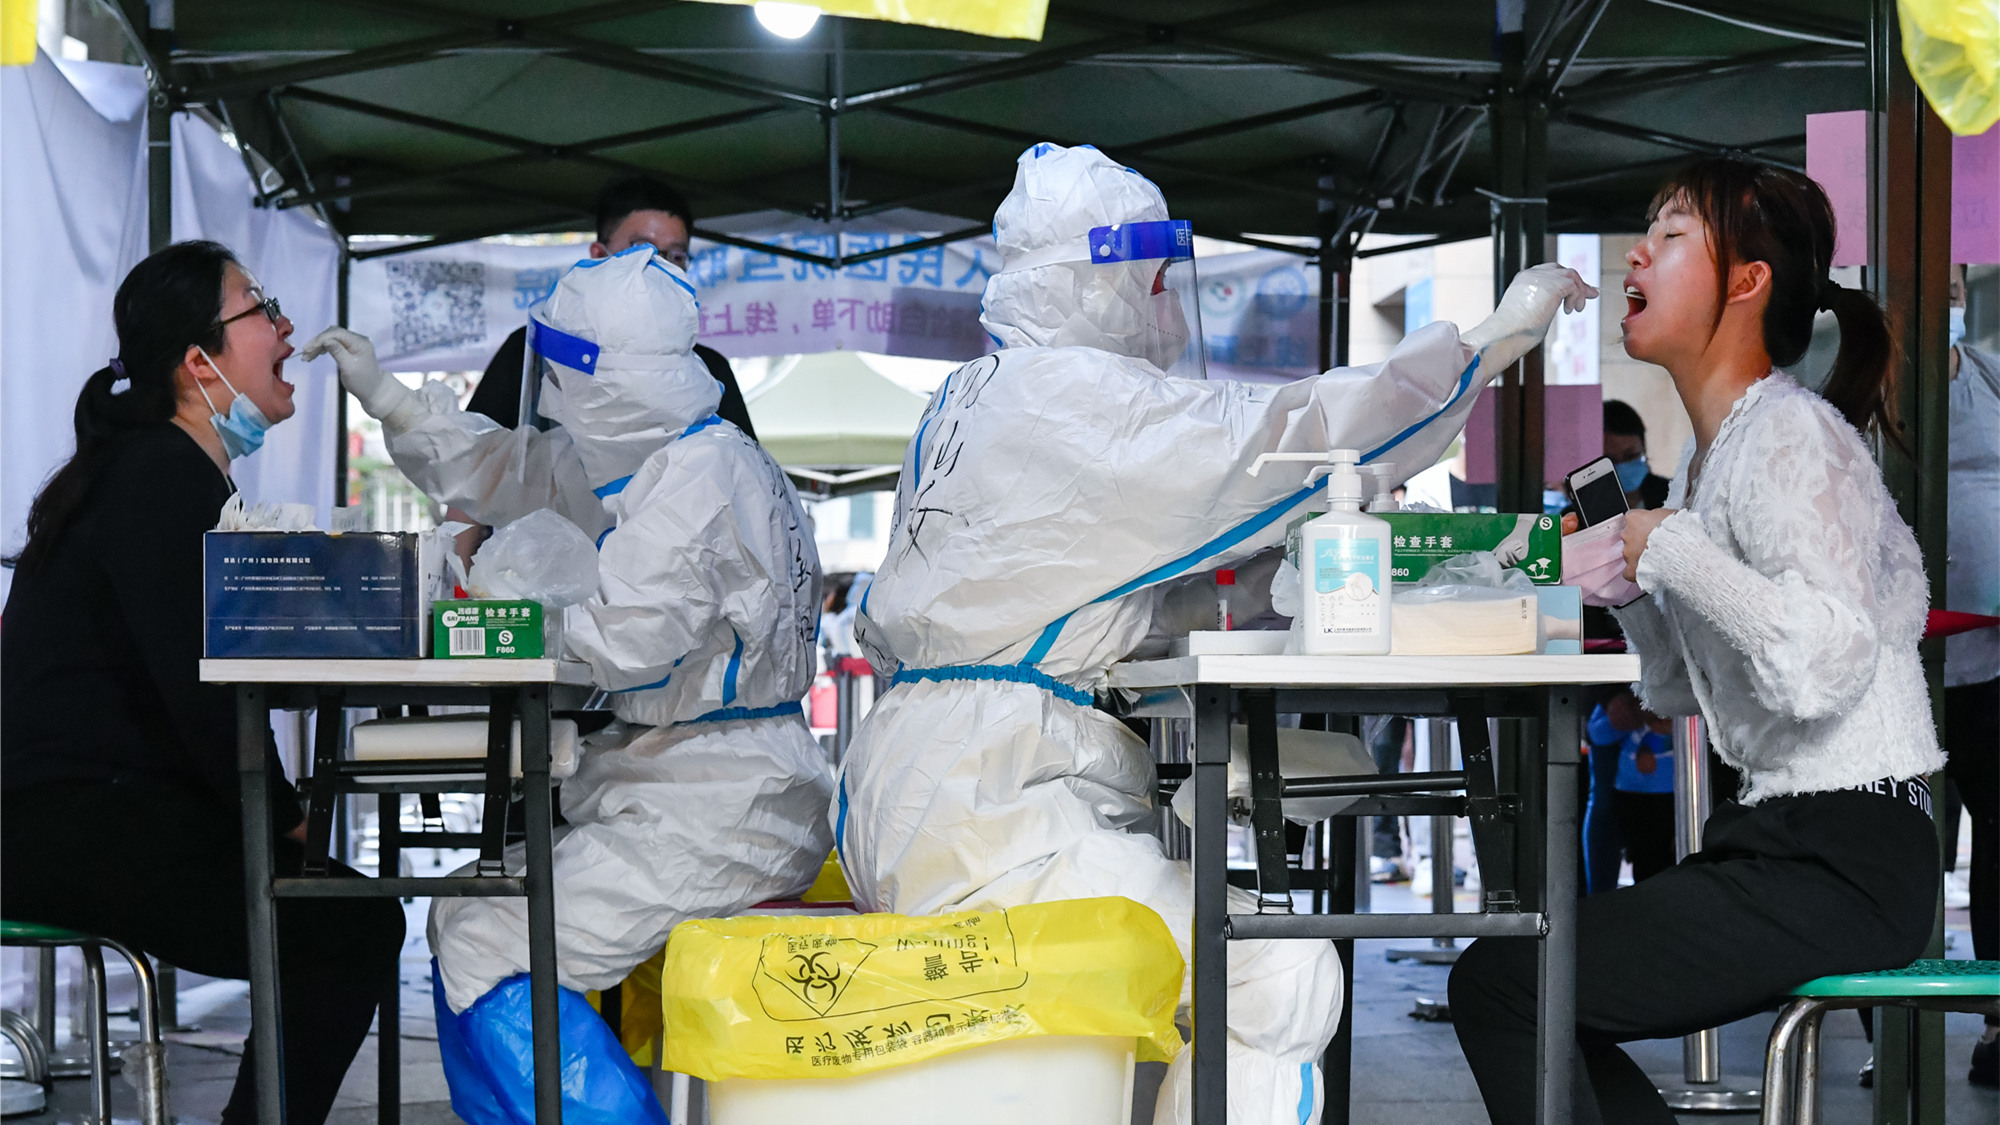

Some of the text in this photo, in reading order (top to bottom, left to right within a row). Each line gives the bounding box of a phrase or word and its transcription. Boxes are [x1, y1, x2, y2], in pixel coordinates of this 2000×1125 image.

[1393, 535, 1452, 548] 检查手套
[485, 607, 530, 618] 检查手套
[501, 632, 510, 643] S
[496, 646, 515, 654] F860
